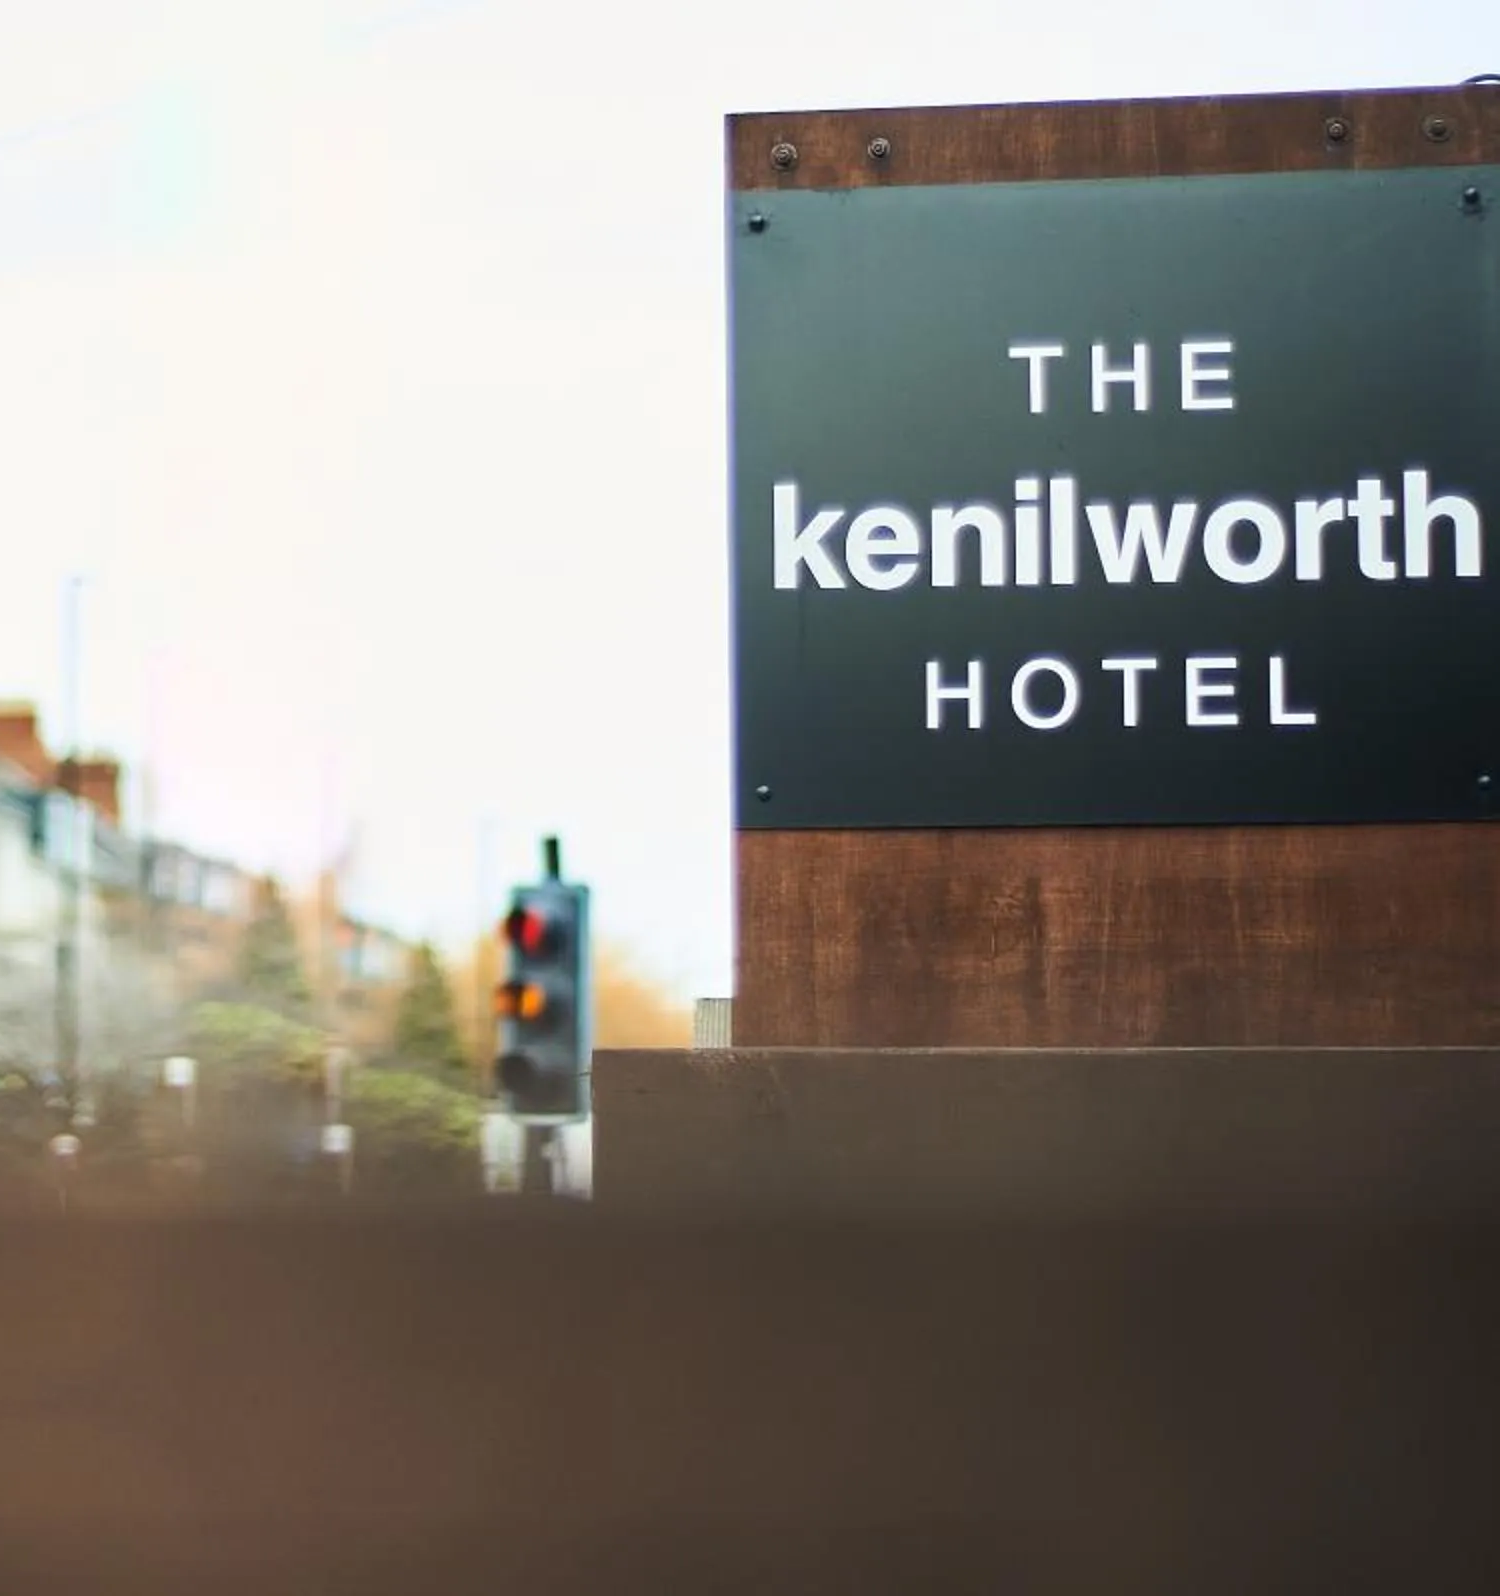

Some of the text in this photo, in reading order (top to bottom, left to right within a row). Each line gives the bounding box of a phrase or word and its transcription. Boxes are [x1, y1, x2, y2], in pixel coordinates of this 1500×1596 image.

[1008, 341, 1235, 414] THE
[773, 469, 1482, 590] kenilworth
[925, 657, 1318, 729] HOTEL
